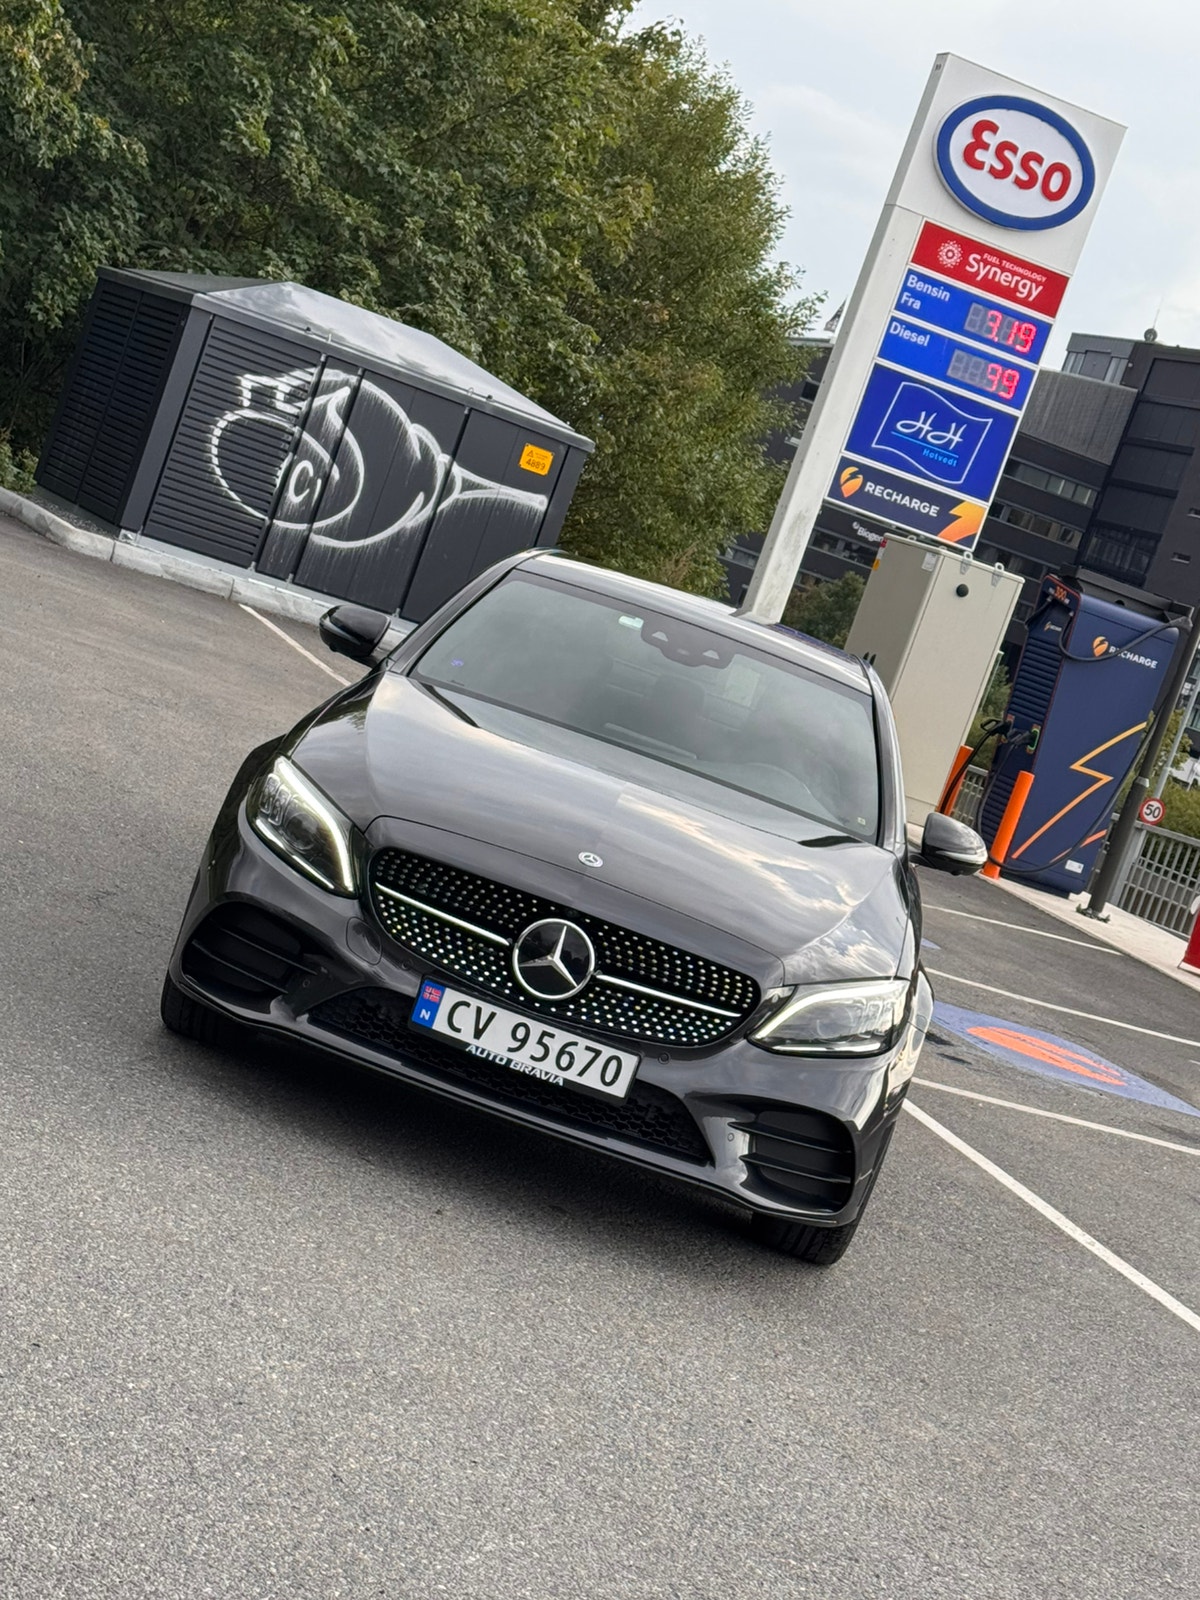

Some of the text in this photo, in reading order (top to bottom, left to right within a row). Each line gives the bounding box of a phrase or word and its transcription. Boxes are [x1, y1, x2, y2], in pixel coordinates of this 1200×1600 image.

[965, 253, 1043, 301] Synergy
[983, 253, 1047, 282] FUEL TECHNOLOGY
[900, 292, 921, 310] Fra
[906, 274, 950, 301] Bensin
[889, 321, 930, 346] Diesel
[922, 449, 958, 467] Hotvedt
[864, 482, 940, 517] RECHARGE
[1144, 803, 1161, 819] 50
[420, 1008, 431, 1021] N
[447, 1000, 623, 1087] CV 95670
[465, 1043, 564, 1087] AUTO BRAVIA
